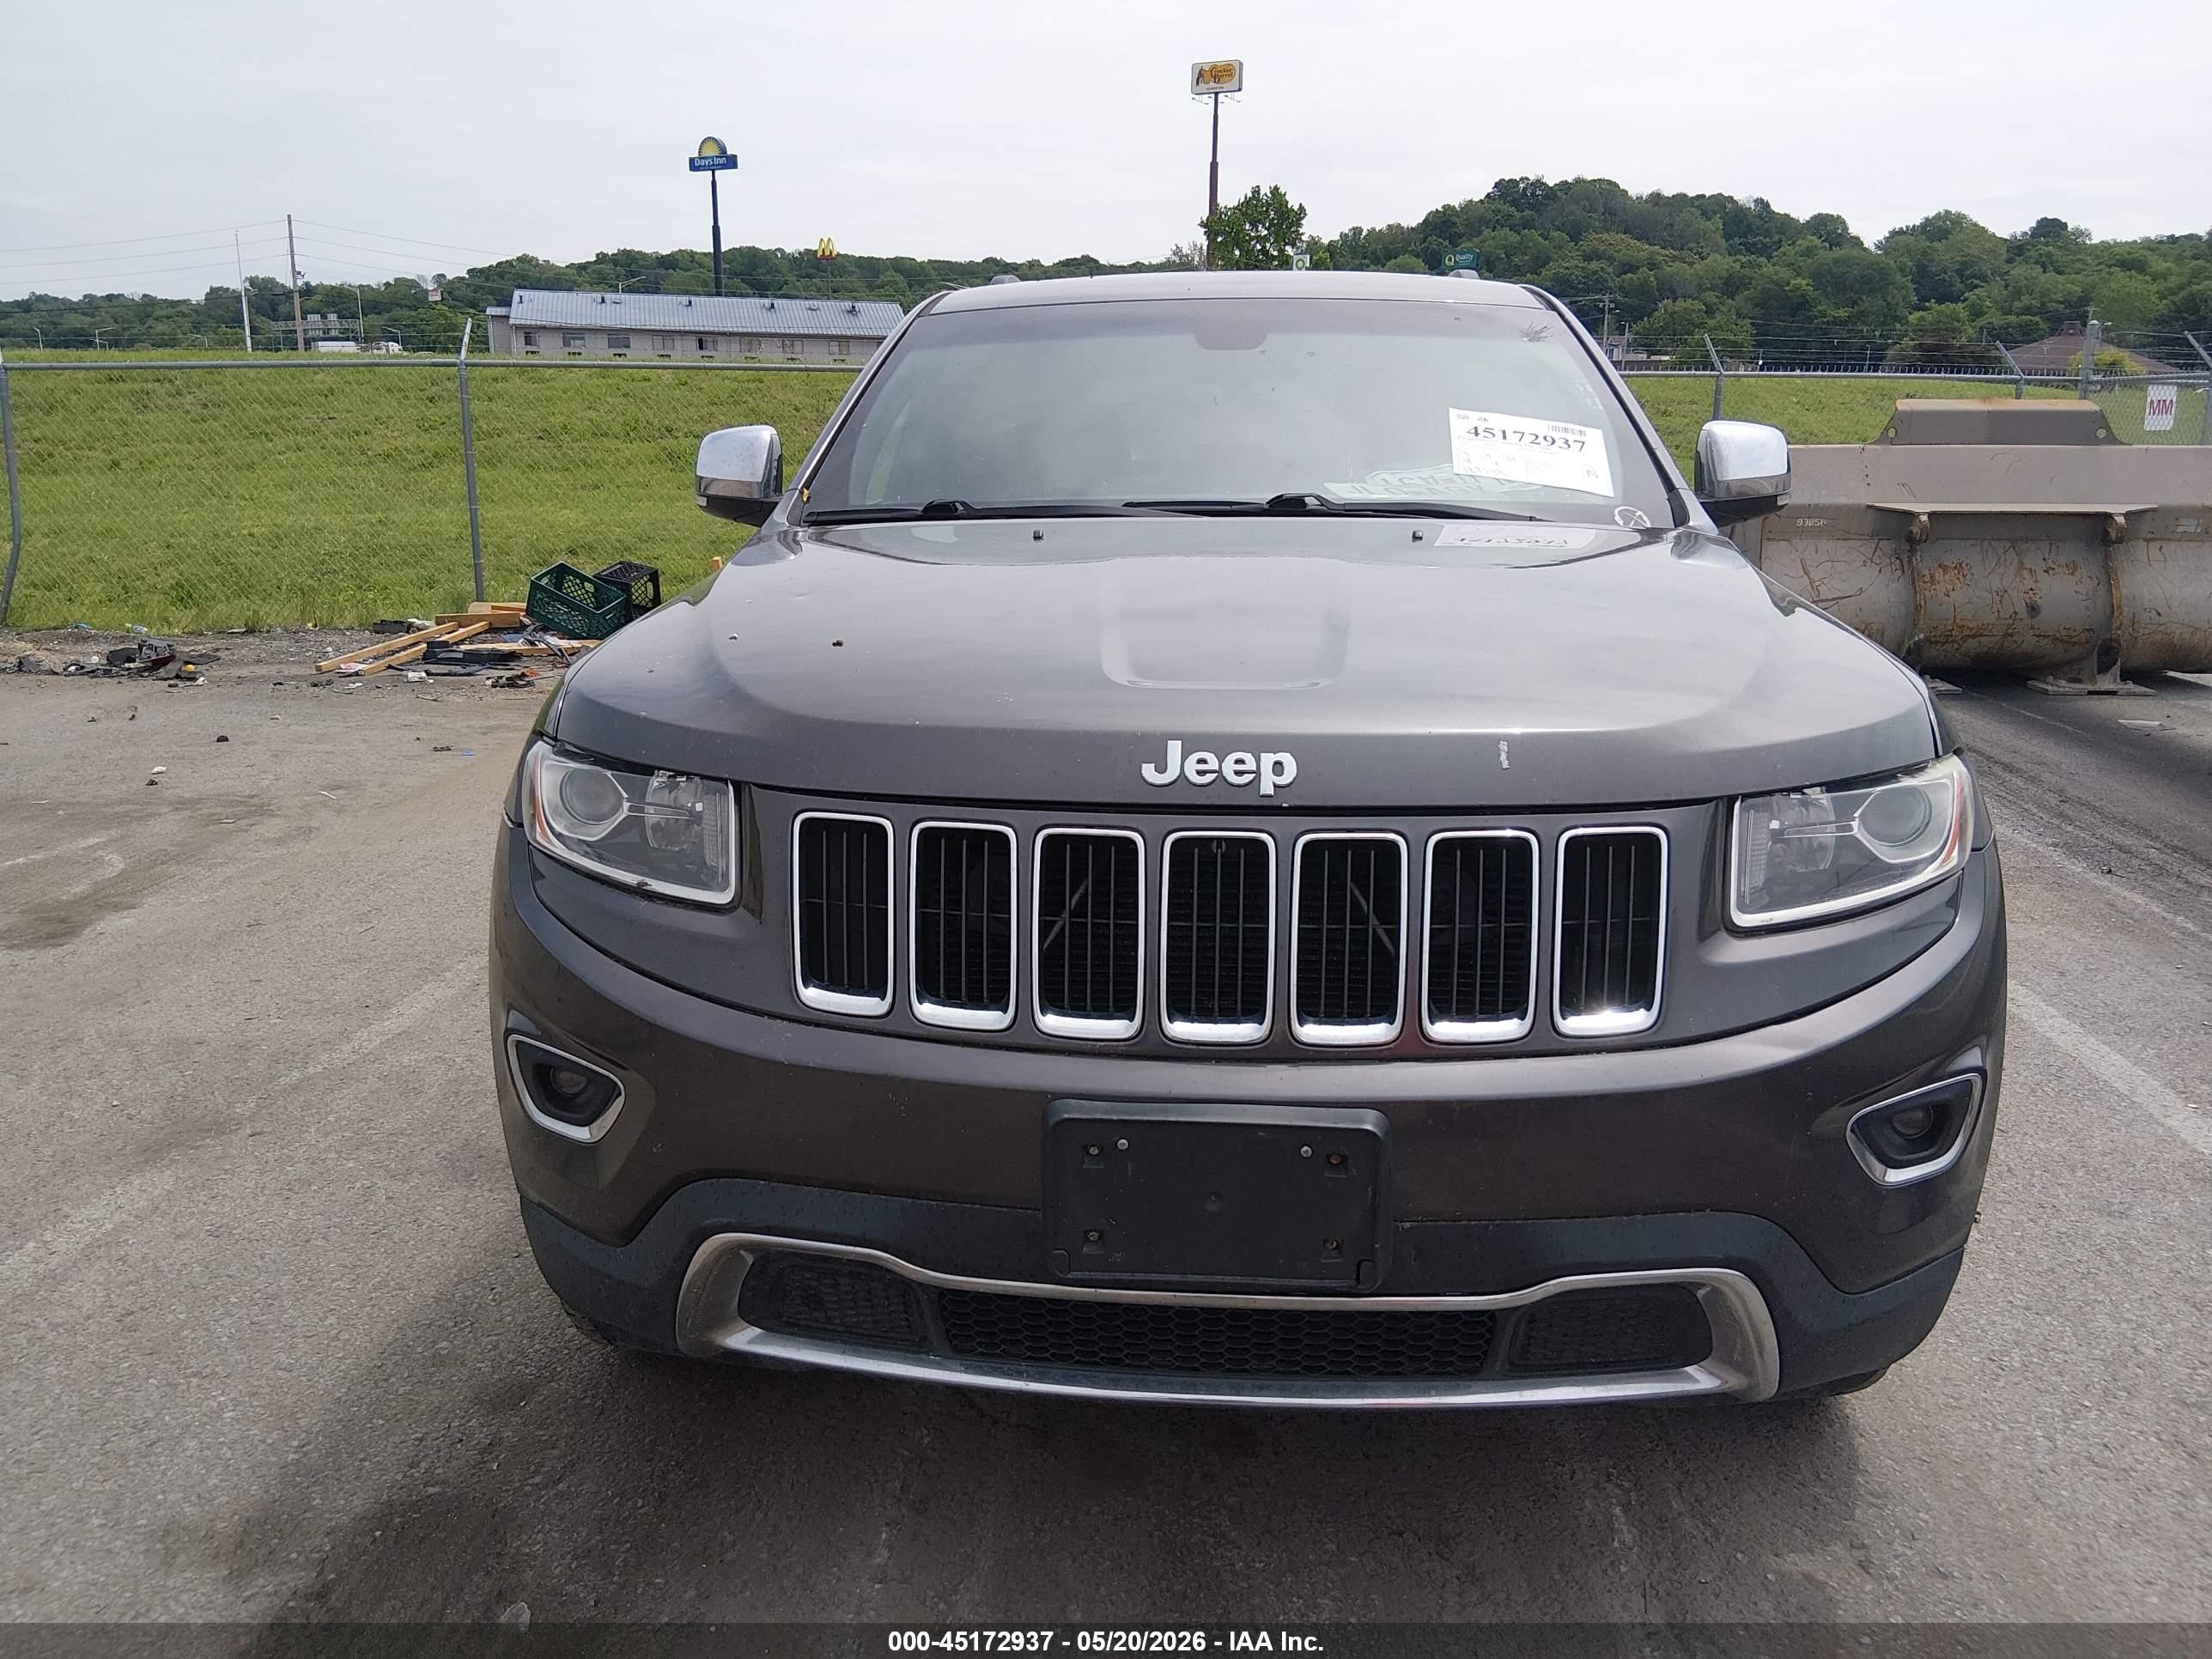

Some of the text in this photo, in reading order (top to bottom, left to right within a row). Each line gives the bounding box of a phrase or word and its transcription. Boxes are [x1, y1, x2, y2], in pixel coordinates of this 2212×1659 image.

[694, 158, 713, 167] Days
[1455, 253, 1474, 262] Quality
[2148, 399, 2173, 416] MM
[1467, 425, 1586, 453] 45172937
[1141, 739, 1297, 797] Jeep
